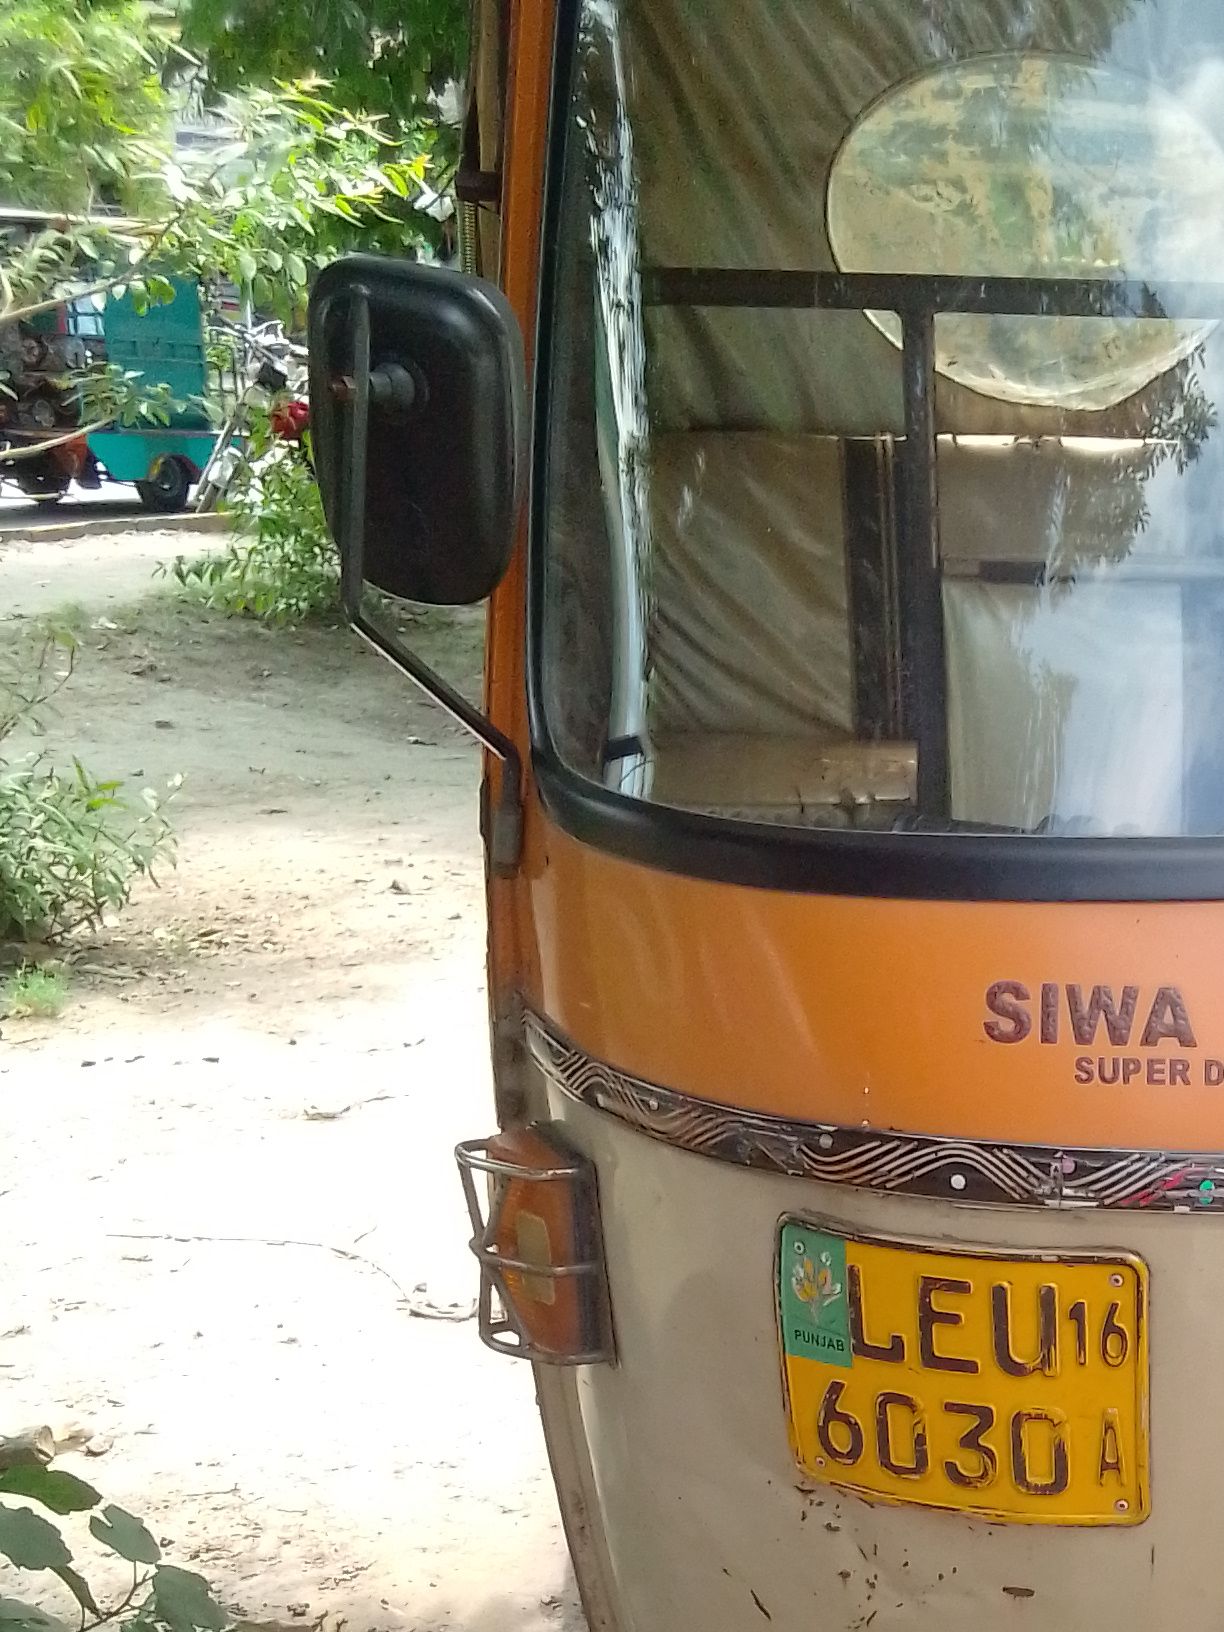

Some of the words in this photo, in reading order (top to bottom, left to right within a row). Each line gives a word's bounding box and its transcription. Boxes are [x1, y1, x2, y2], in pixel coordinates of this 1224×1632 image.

[983, 980, 1198, 1048] SIWA
[1074, 1056, 1192, 1086] SUPER
[793, 1328, 845, 1353] PUNJAB
[816, 1379, 1069, 1495] 6030
[1098, 1408, 1126, 1487] A
